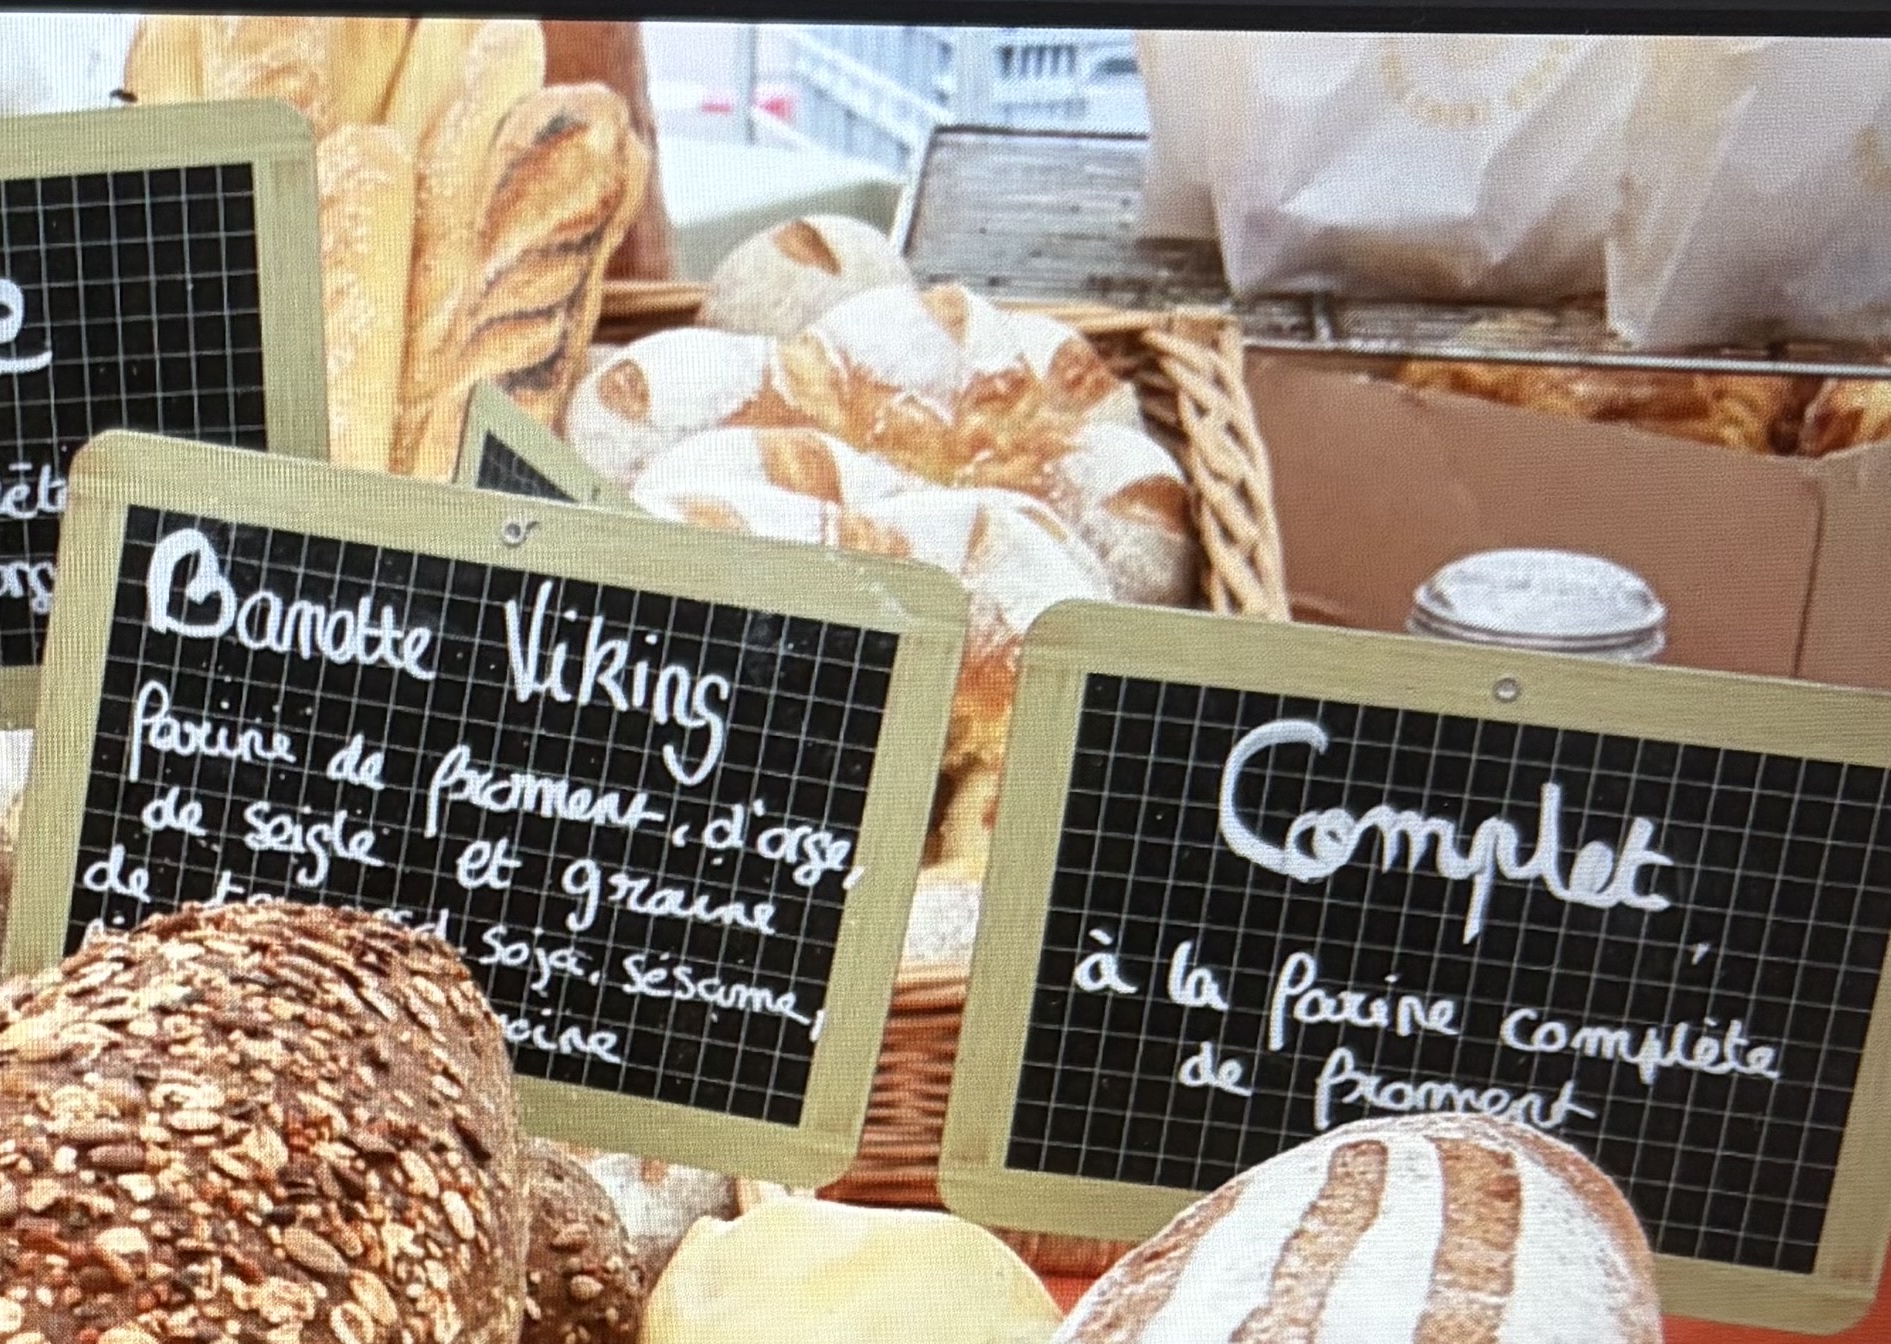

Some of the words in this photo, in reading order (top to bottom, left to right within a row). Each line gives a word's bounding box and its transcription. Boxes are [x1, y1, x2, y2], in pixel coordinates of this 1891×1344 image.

[129, 680, 298, 783] farine
[327, 733, 386, 791] de
[504, 580, 731, 787] Viking
[83, 843, 151, 903] de
[142, 785, 206, 837] de
[243, 800, 385, 888] seigle
[456, 839, 522, 889] et
[1218, 719, 1675, 944] Complet
[1074, 928, 1138, 995] à
[1168, 939, 1230, 1013] la
[1269, 951, 1461, 1052] farine
[1178, 1041, 1253, 1097] de
